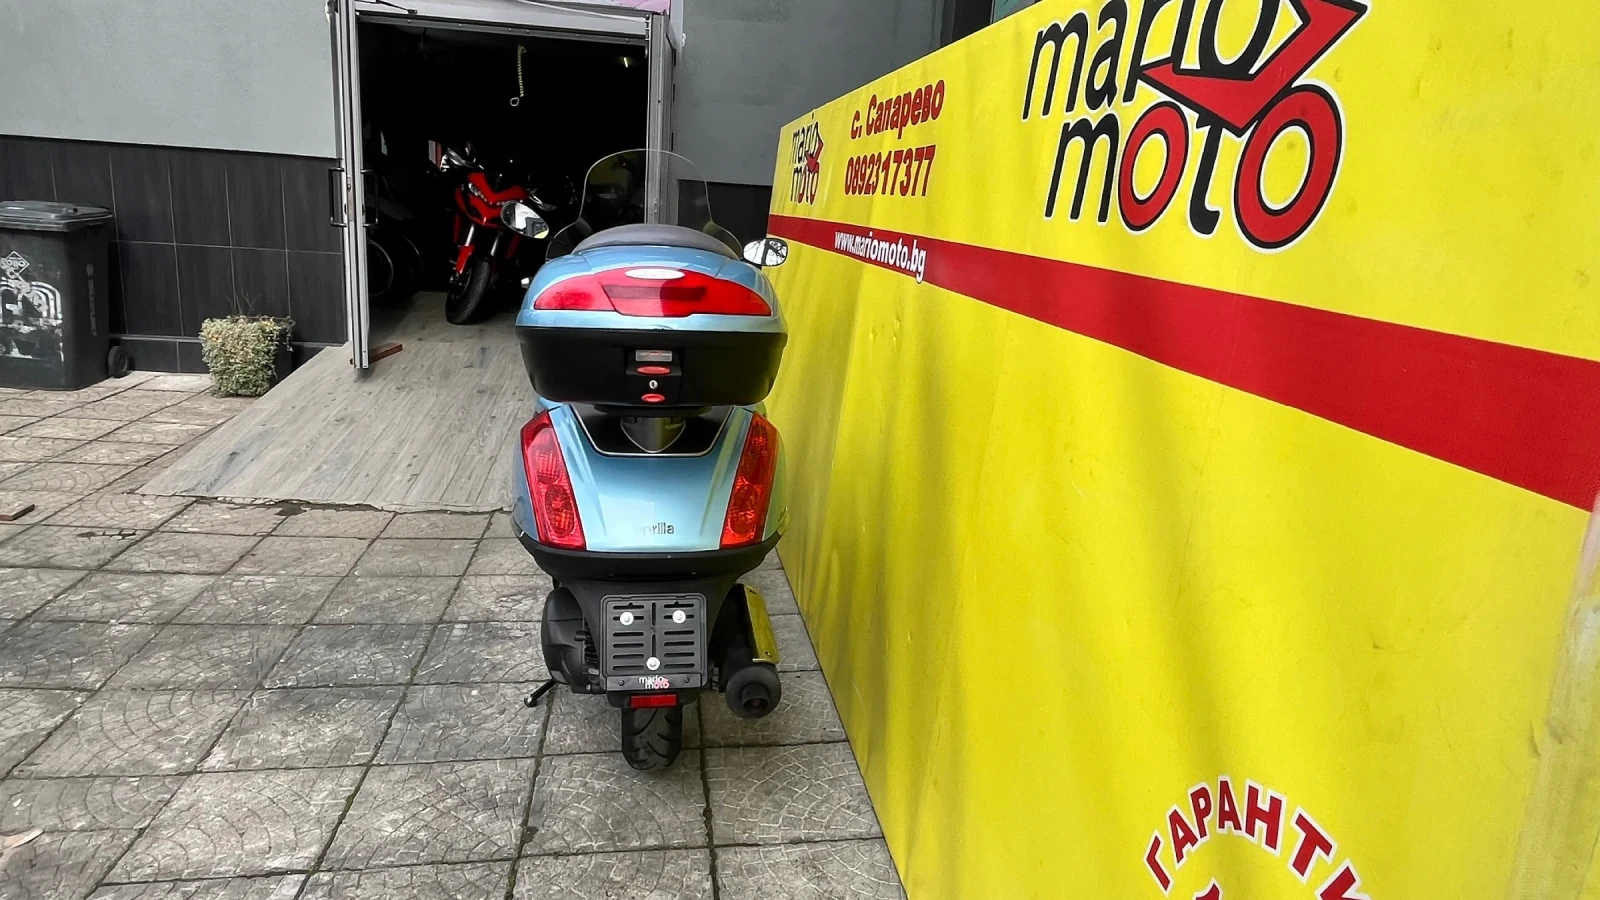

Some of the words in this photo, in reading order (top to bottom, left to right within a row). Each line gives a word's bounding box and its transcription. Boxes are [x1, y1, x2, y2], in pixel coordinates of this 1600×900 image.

[1022, 0, 1290, 119] mario
[866, 79, 945, 139] Сапарево
[789, 112, 820, 165] mario
[790, 162, 820, 205] moto
[844, 145, 936, 197] 0892317377
[1044, 84, 1343, 249] moto
[834, 231, 927, 284] www.mariomoto.bg
[638, 674, 665, 685] mario
[644, 681, 670, 690] moto
